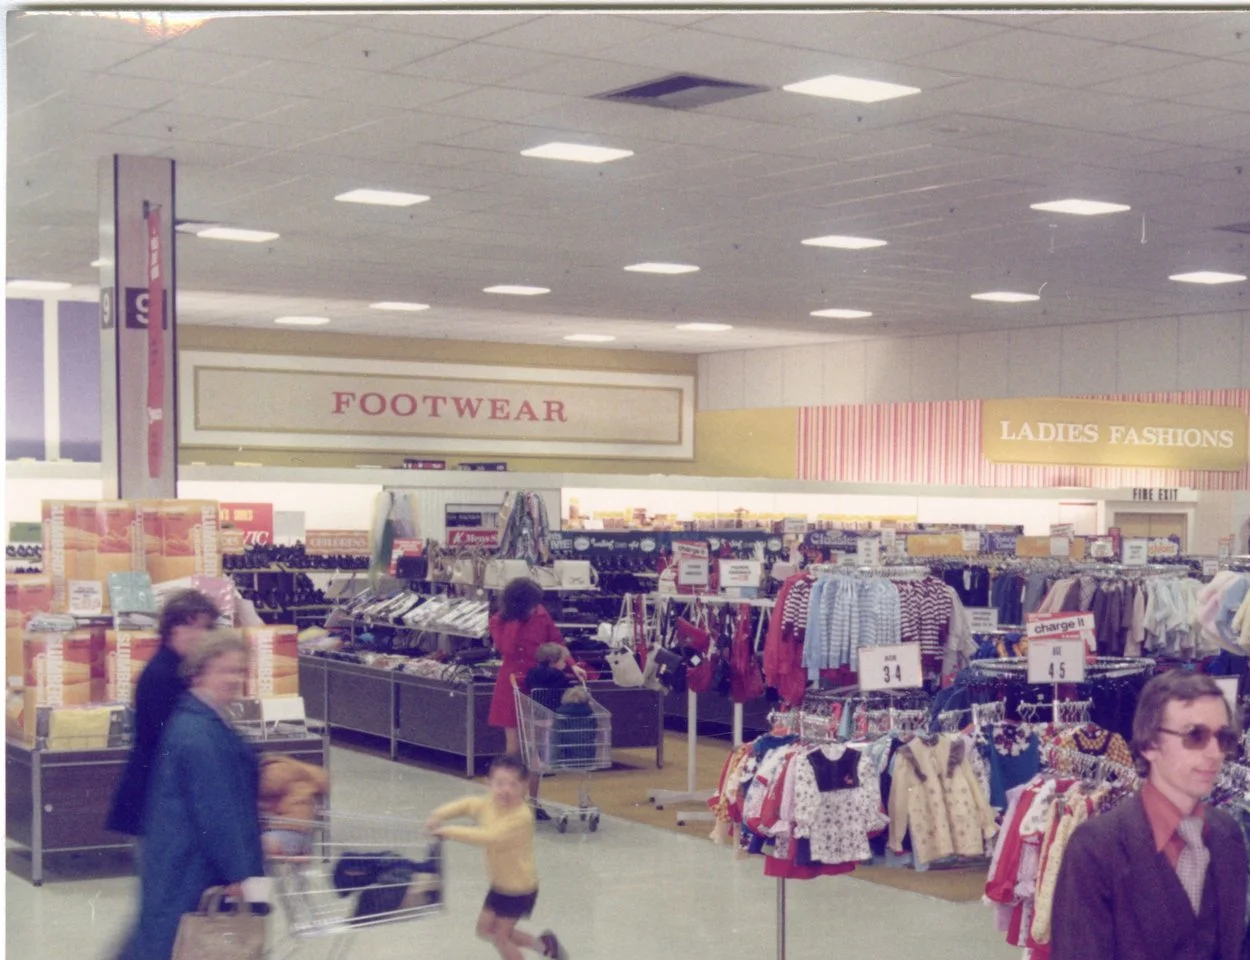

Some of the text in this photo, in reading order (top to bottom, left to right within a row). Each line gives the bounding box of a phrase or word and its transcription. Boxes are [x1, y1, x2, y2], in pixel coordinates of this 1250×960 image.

[332, 391, 568, 423] FOOTWEAR
[1000, 420, 1234, 448] LADIES FASHIONS
[1133, 488, 1178, 501] FIRE EXIT
[1034, 617, 1085, 634] charge it
[883, 665, 902, 683] 3 4
[1048, 662, 1066, 679] 4 5
